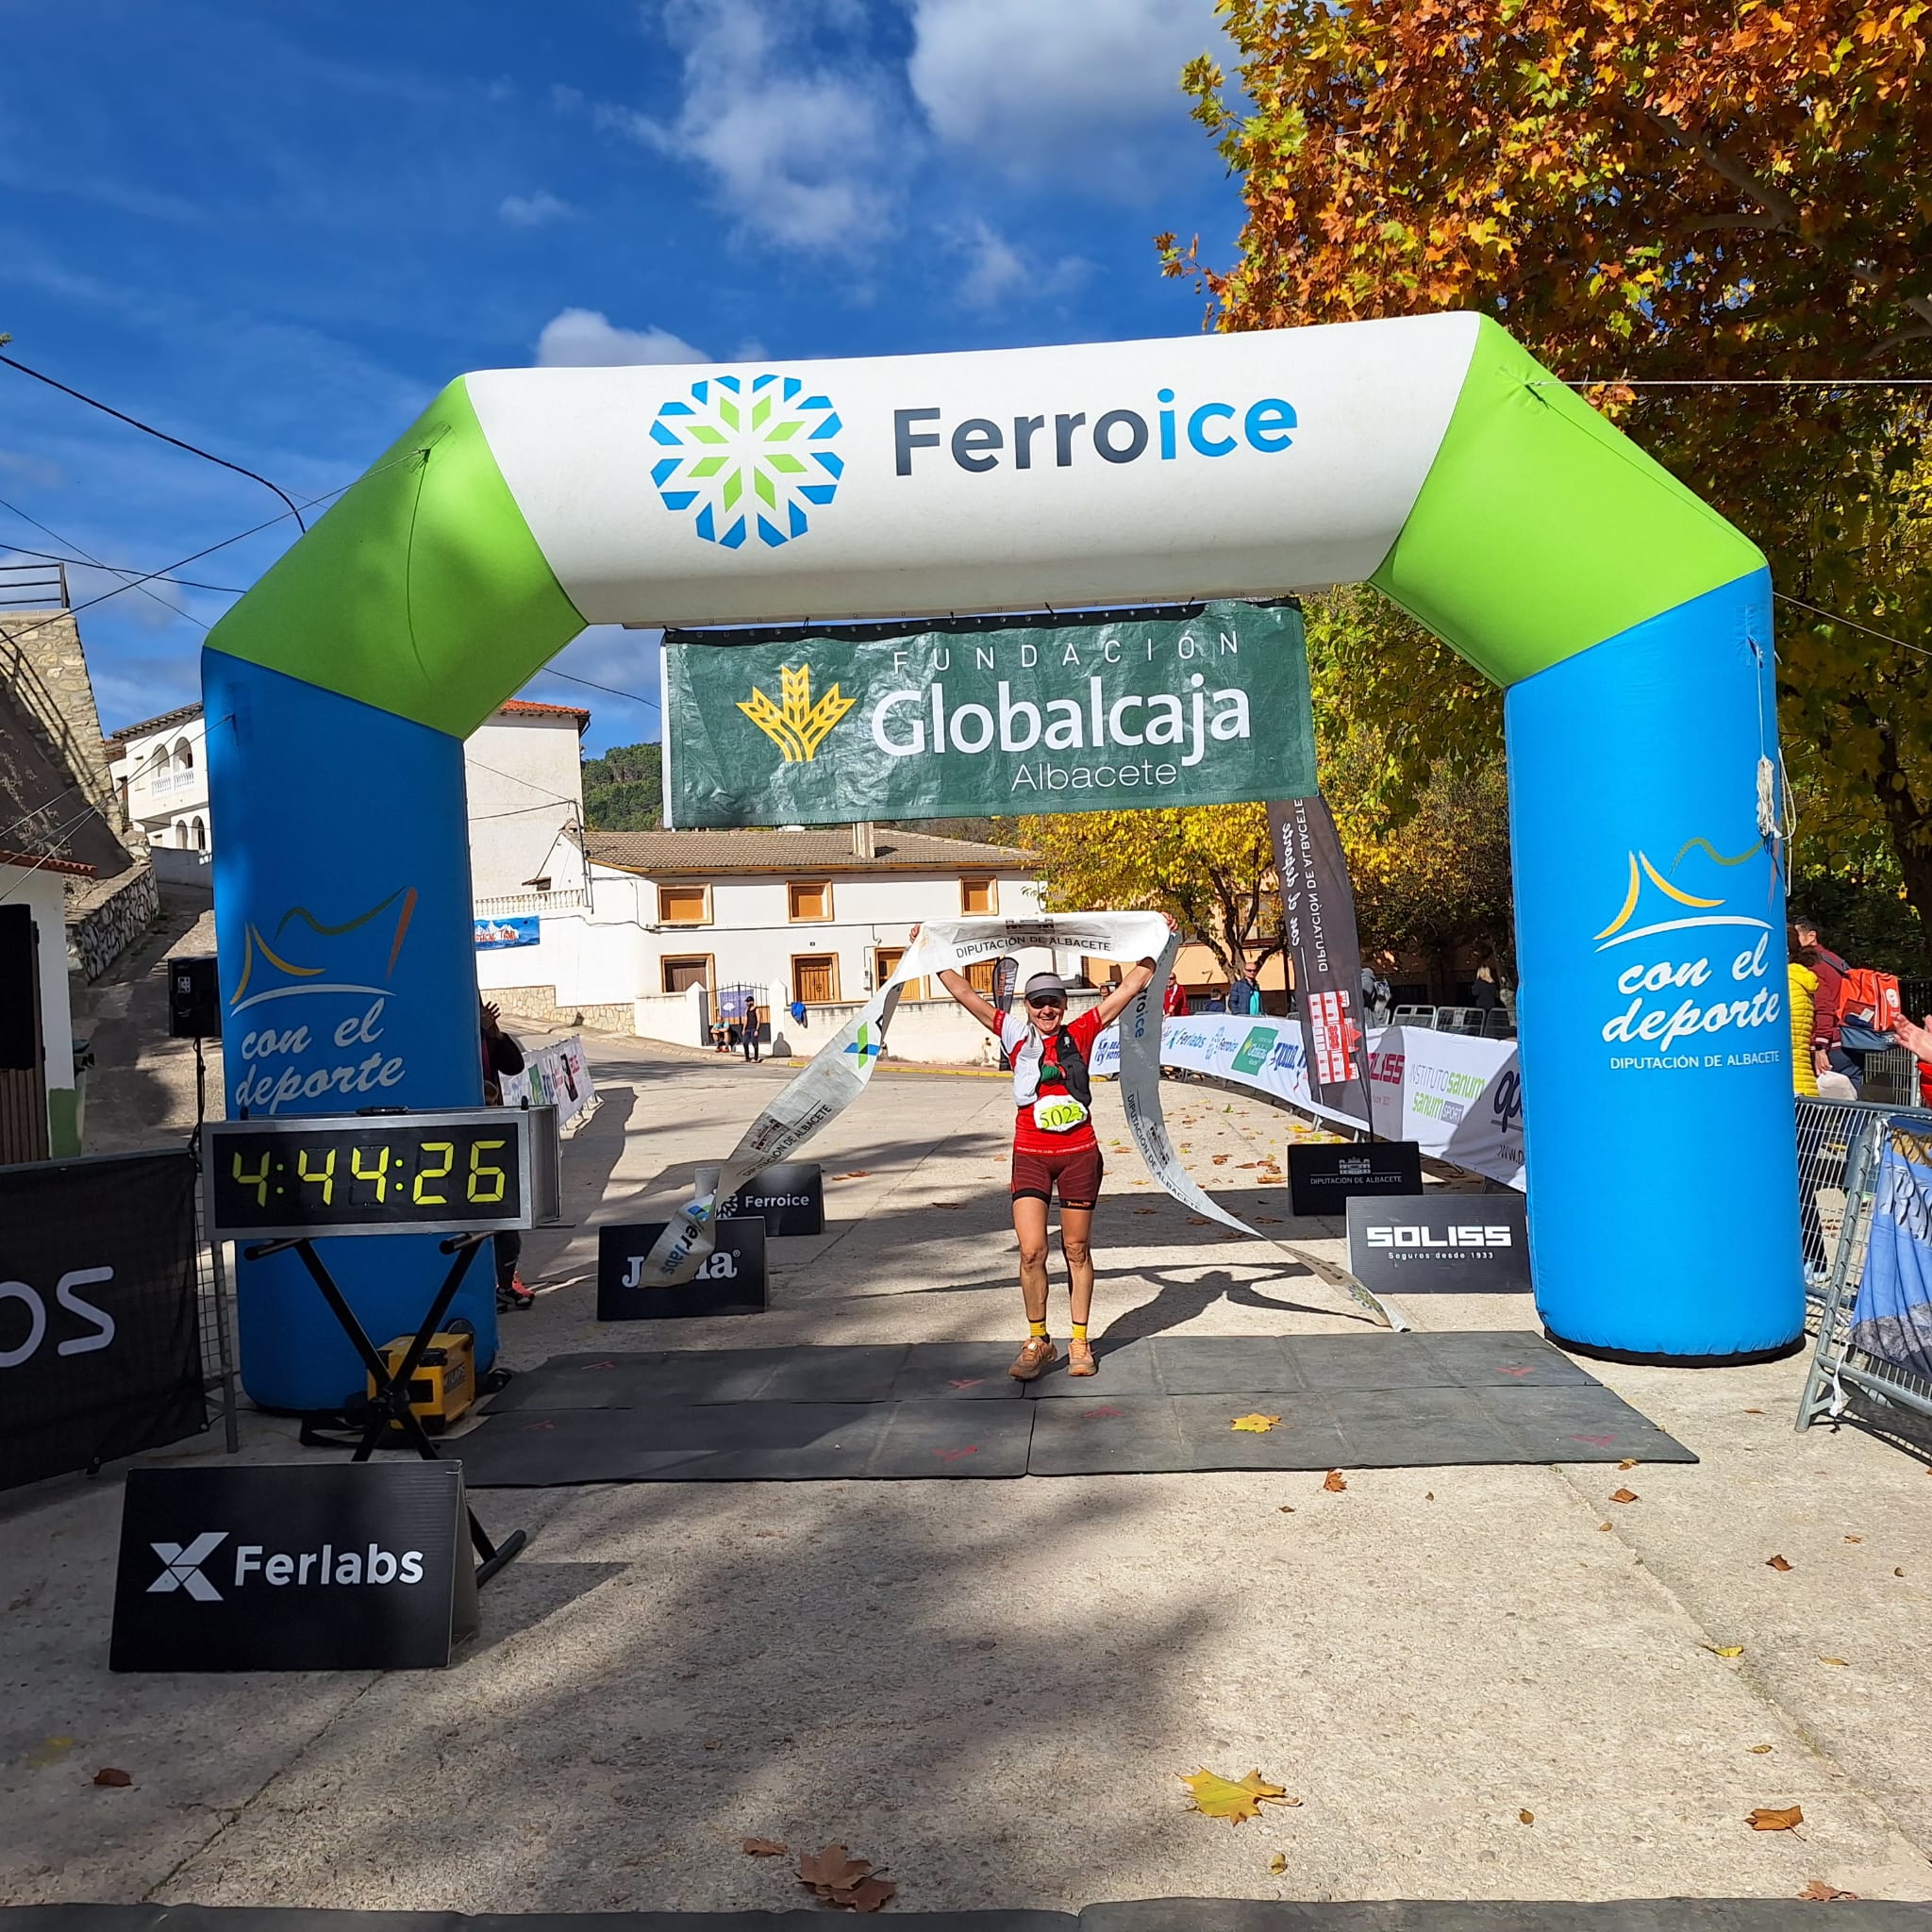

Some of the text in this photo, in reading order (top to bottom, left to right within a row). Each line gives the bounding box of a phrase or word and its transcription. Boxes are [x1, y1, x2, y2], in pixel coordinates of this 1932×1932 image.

[894, 388, 1297, 475] Ferroice
[892, 630, 1238, 675] FUNDACIÓN
[872, 673, 1251, 766] Globalcaja
[1011, 759, 1177, 791] Albacete
[956, 936, 1111, 958] DIPUTACIÓN DE ALBACETE
[1618, 931, 1769, 994] con el
[241, 997, 385, 1060] con el
[1602, 986, 1781, 1052] deporte
[1610, 1050, 1781, 1070] DIPUTACIÓN DE ALBACETE
[235, 1052, 406, 1115] deporte
[1412, 1091, 1443, 1120] sanum
[782, 1135, 798, 1148] DE
[795, 1104, 832, 1140] ALBACETE
[1127, 1093, 1150, 1155] DIPUTACIÓN
[1148, 1153, 1158, 1170] DE
[232, 1140, 507, 1208] 4:44:26
[1366, 1175, 1403, 1184] ALBACETE
[744, 1193, 810, 1208] Ferroice
[1367, 1226, 1511, 1247] SOLISS
[1388, 1251, 1494, 1260] Seguros desde 1933
[235, 1543, 425, 1587] Ferlabs
